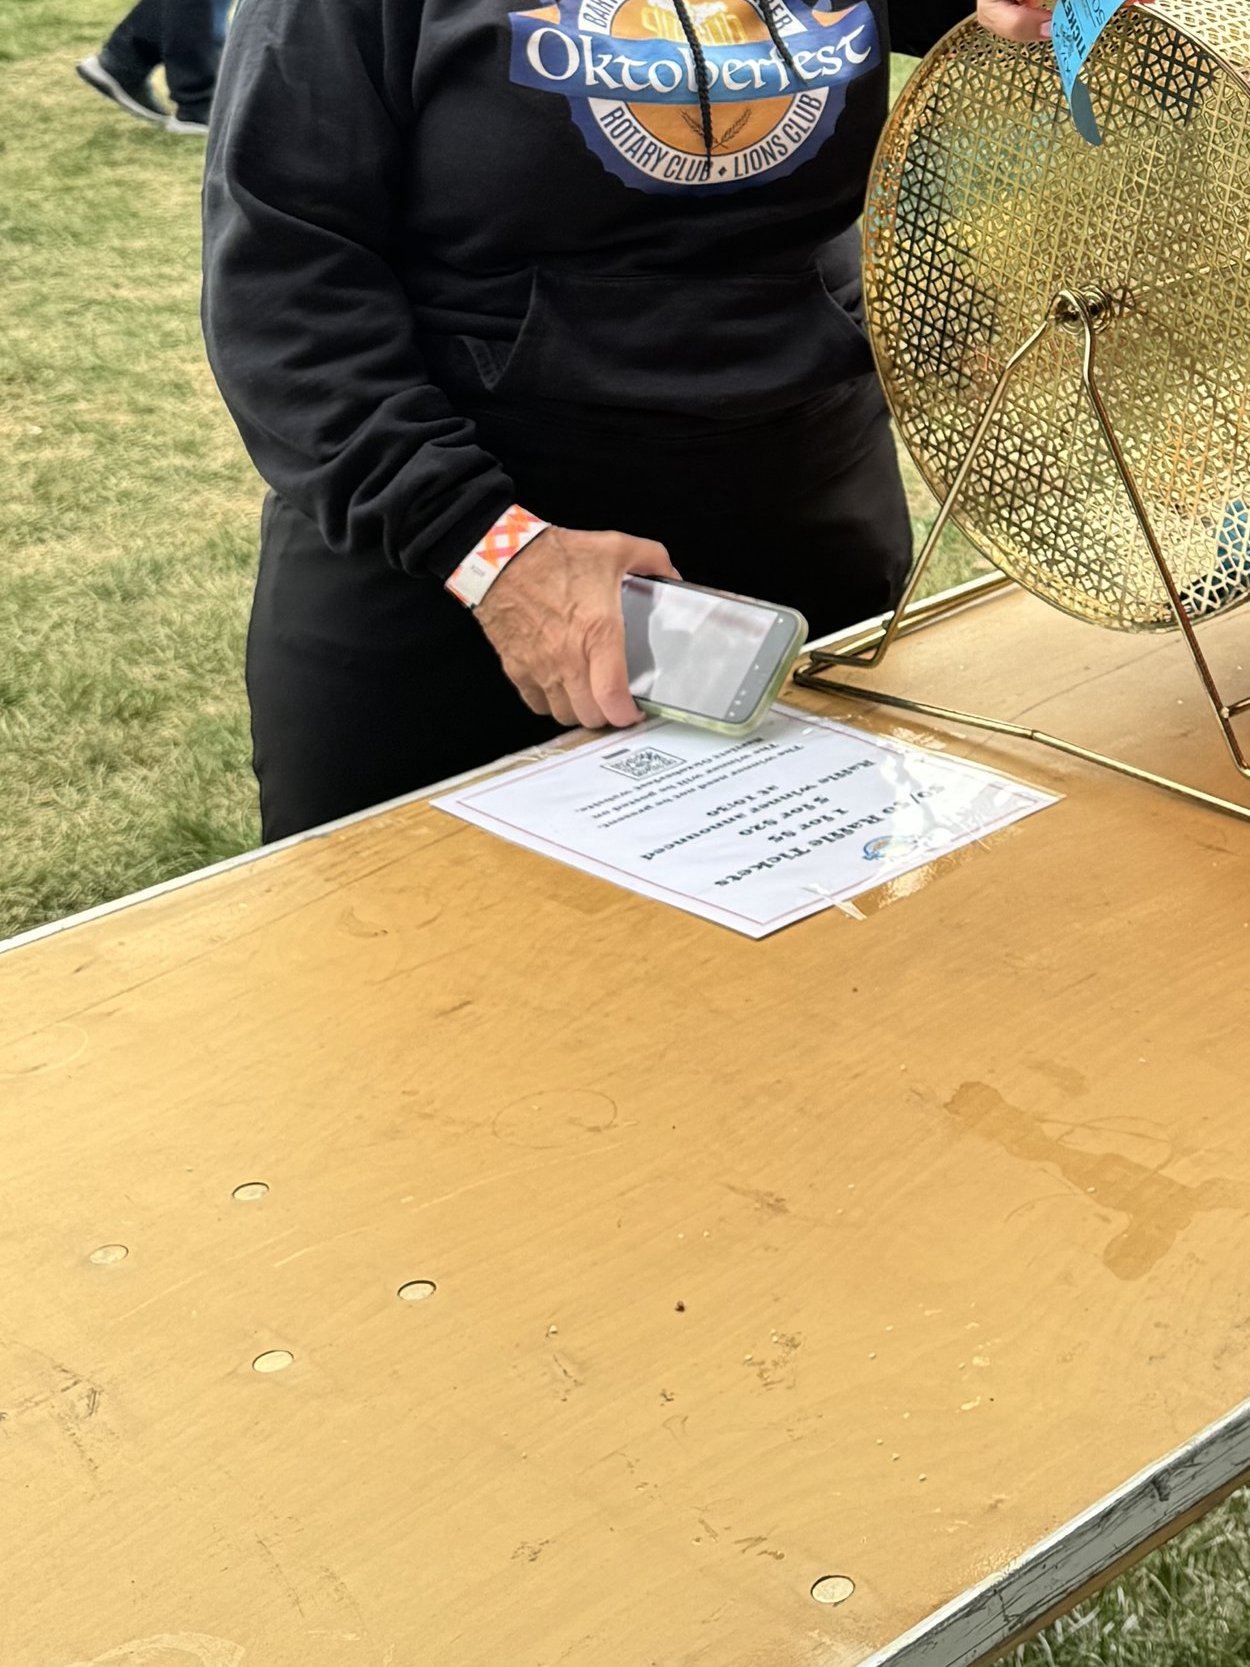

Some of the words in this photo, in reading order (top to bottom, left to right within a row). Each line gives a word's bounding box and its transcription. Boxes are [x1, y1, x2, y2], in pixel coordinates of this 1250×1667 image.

[527, 24, 872, 94] Oktoberfest
[600, 106, 665, 173] ROTARY
[664, 154, 713, 182] CLUB
[734, 137, 788, 177] LIONS
[783, 93, 823, 143] CLUB
[816, 759, 876, 784] Raffle
[748, 784, 819, 814] winner
[779, 803, 817, 820] for
[638, 812, 749, 860] announced
[737, 819, 780, 836] $20
[798, 815, 835, 831] for
[806, 814, 885, 847] Raffle
[712, 846, 812, 887] Tickets
